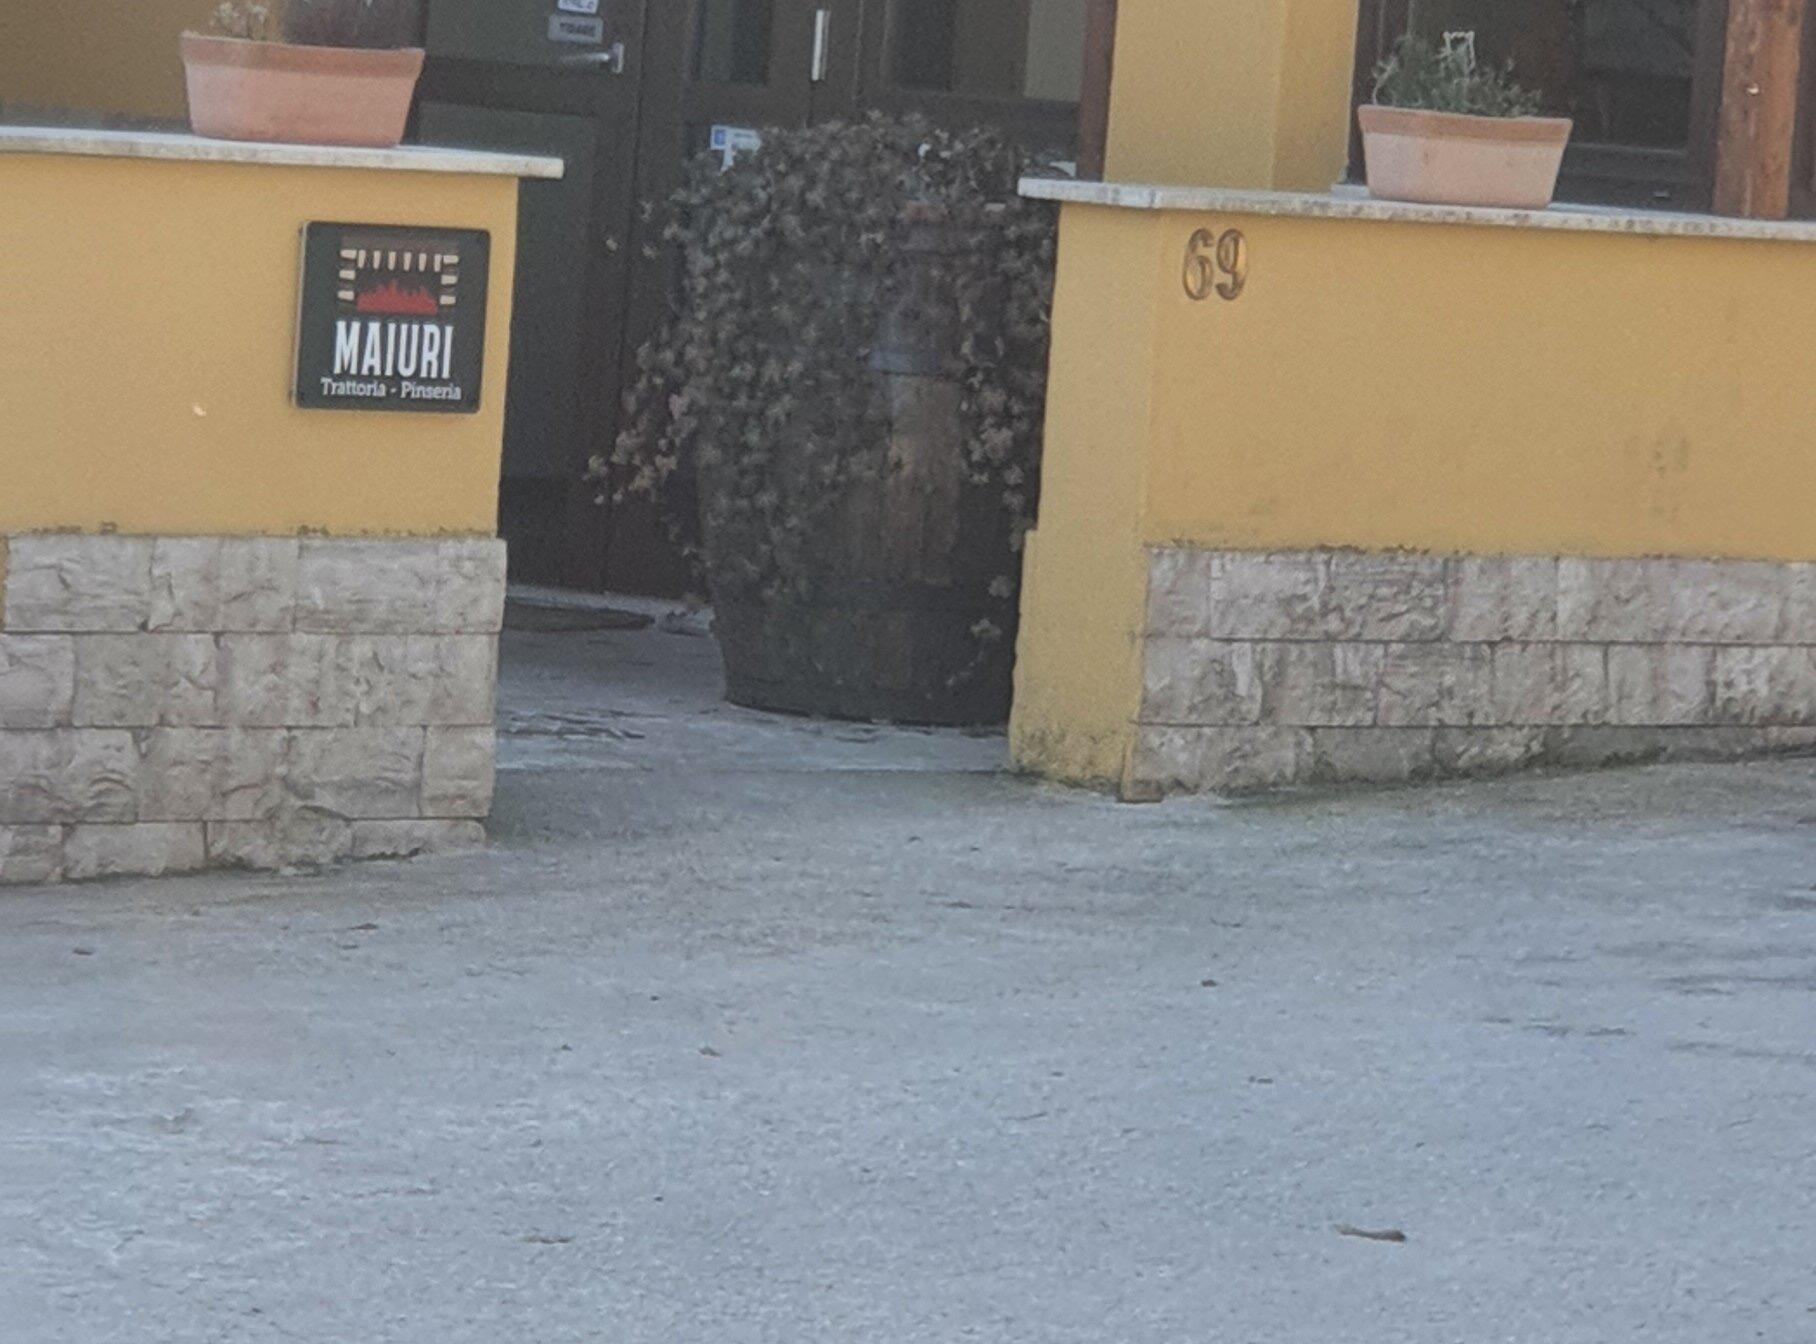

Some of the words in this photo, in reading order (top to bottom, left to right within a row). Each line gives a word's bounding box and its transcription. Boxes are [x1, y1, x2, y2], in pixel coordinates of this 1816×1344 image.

[1182, 228, 1248, 301] 69
[333, 320, 454, 379] MAIURI
[320, 376, 386, 397] Trattoria
[401, 380, 462, 401] Pinseria
